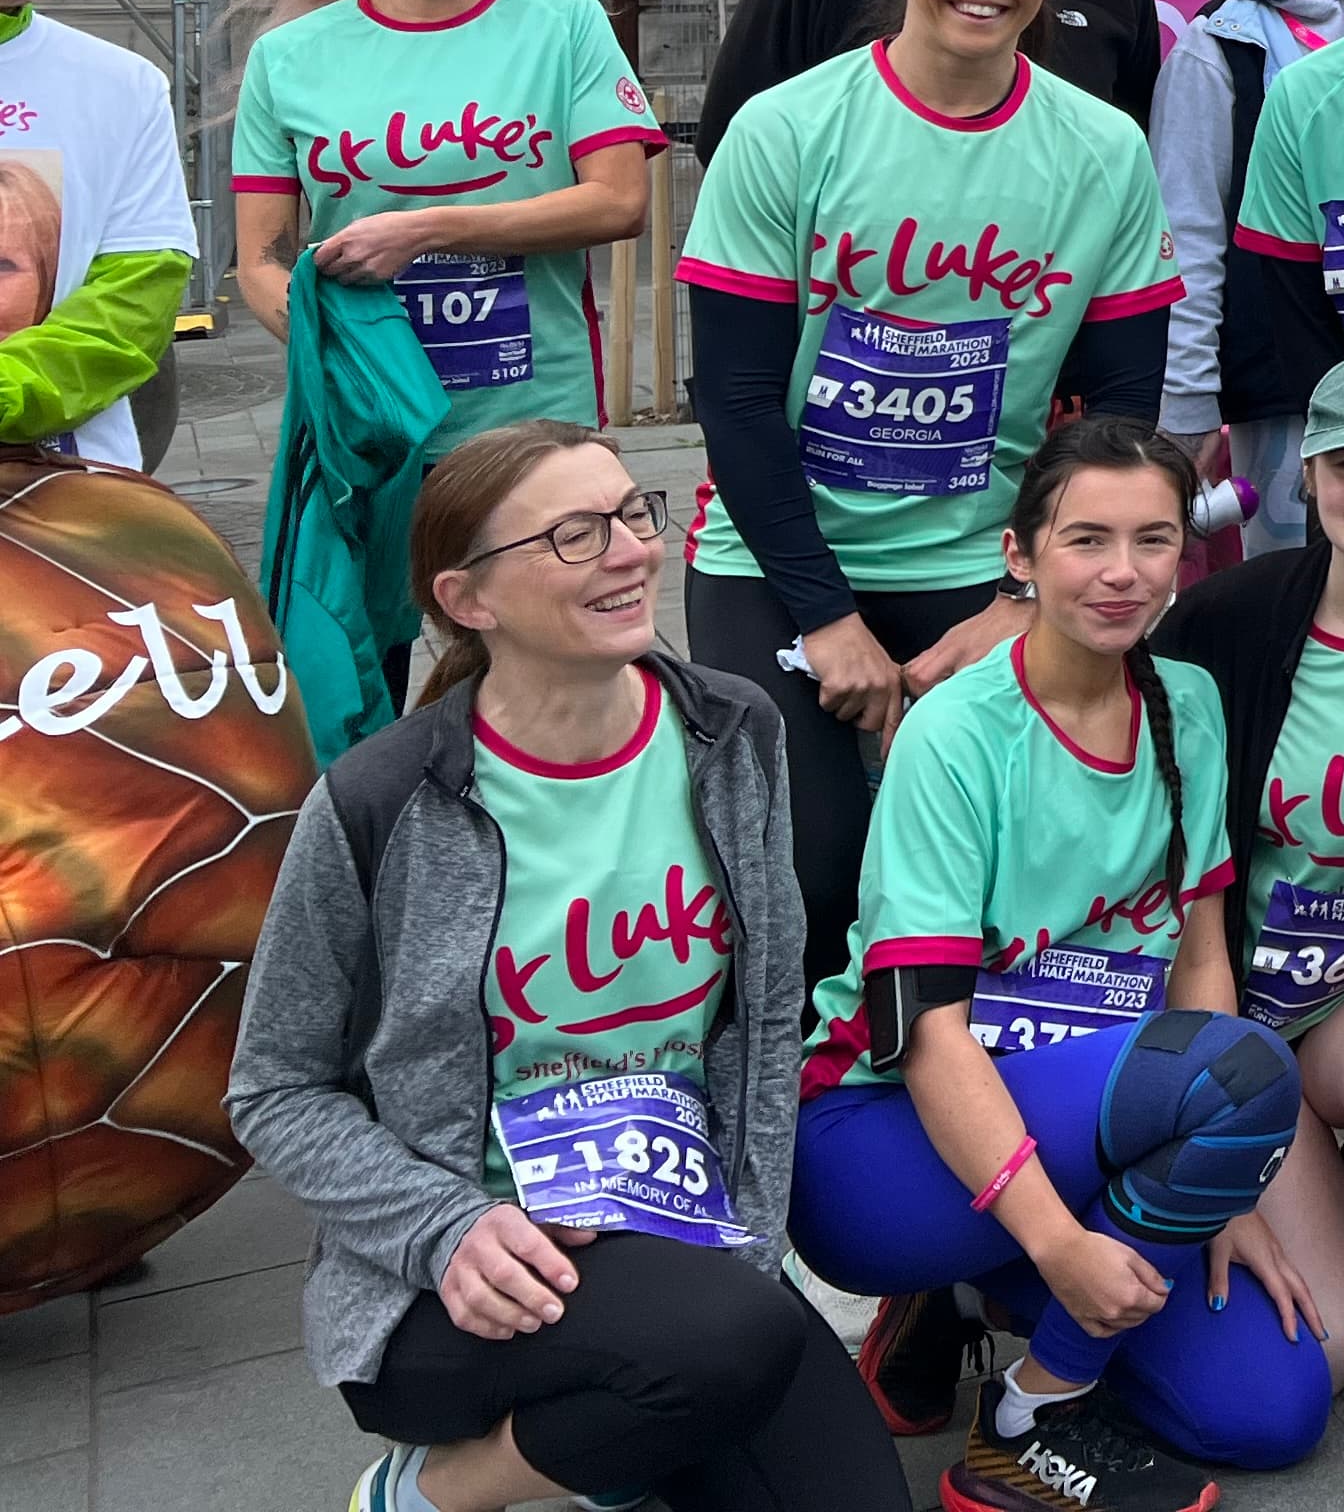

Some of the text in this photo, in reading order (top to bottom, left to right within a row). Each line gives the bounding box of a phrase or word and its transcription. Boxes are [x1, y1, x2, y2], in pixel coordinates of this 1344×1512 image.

[308, 100, 554, 198] St Luke's
[885, 217, 1073, 319] Luke's
[884, 328, 944, 344] SHEFFIELD
[881, 337, 990, 356] HALF MARATHON
[950, 350, 990, 369] 2023
[491, 364, 529, 380] 5107
[843, 380, 974, 424] 3405
[869, 427, 942, 441] GEORGIA
[846, 454, 865, 466] ALL
[948, 473, 986, 489] 3405
[1041, 951, 1107, 970] SHEFFIELD
[1039, 965, 1152, 990] HALF MARATHON
[1102, 989, 1148, 1009] 2023
[584, 1076, 664, 1097] SHEFFIELD
[587, 1089, 630, 1106] HALF
[572, 1129, 710, 1196] 1825
[574, 1176, 690, 1210] IN MEMORY OF
[603, 1212, 626, 1223] ALL
[1016, 1440, 1098, 1508] HOKA
